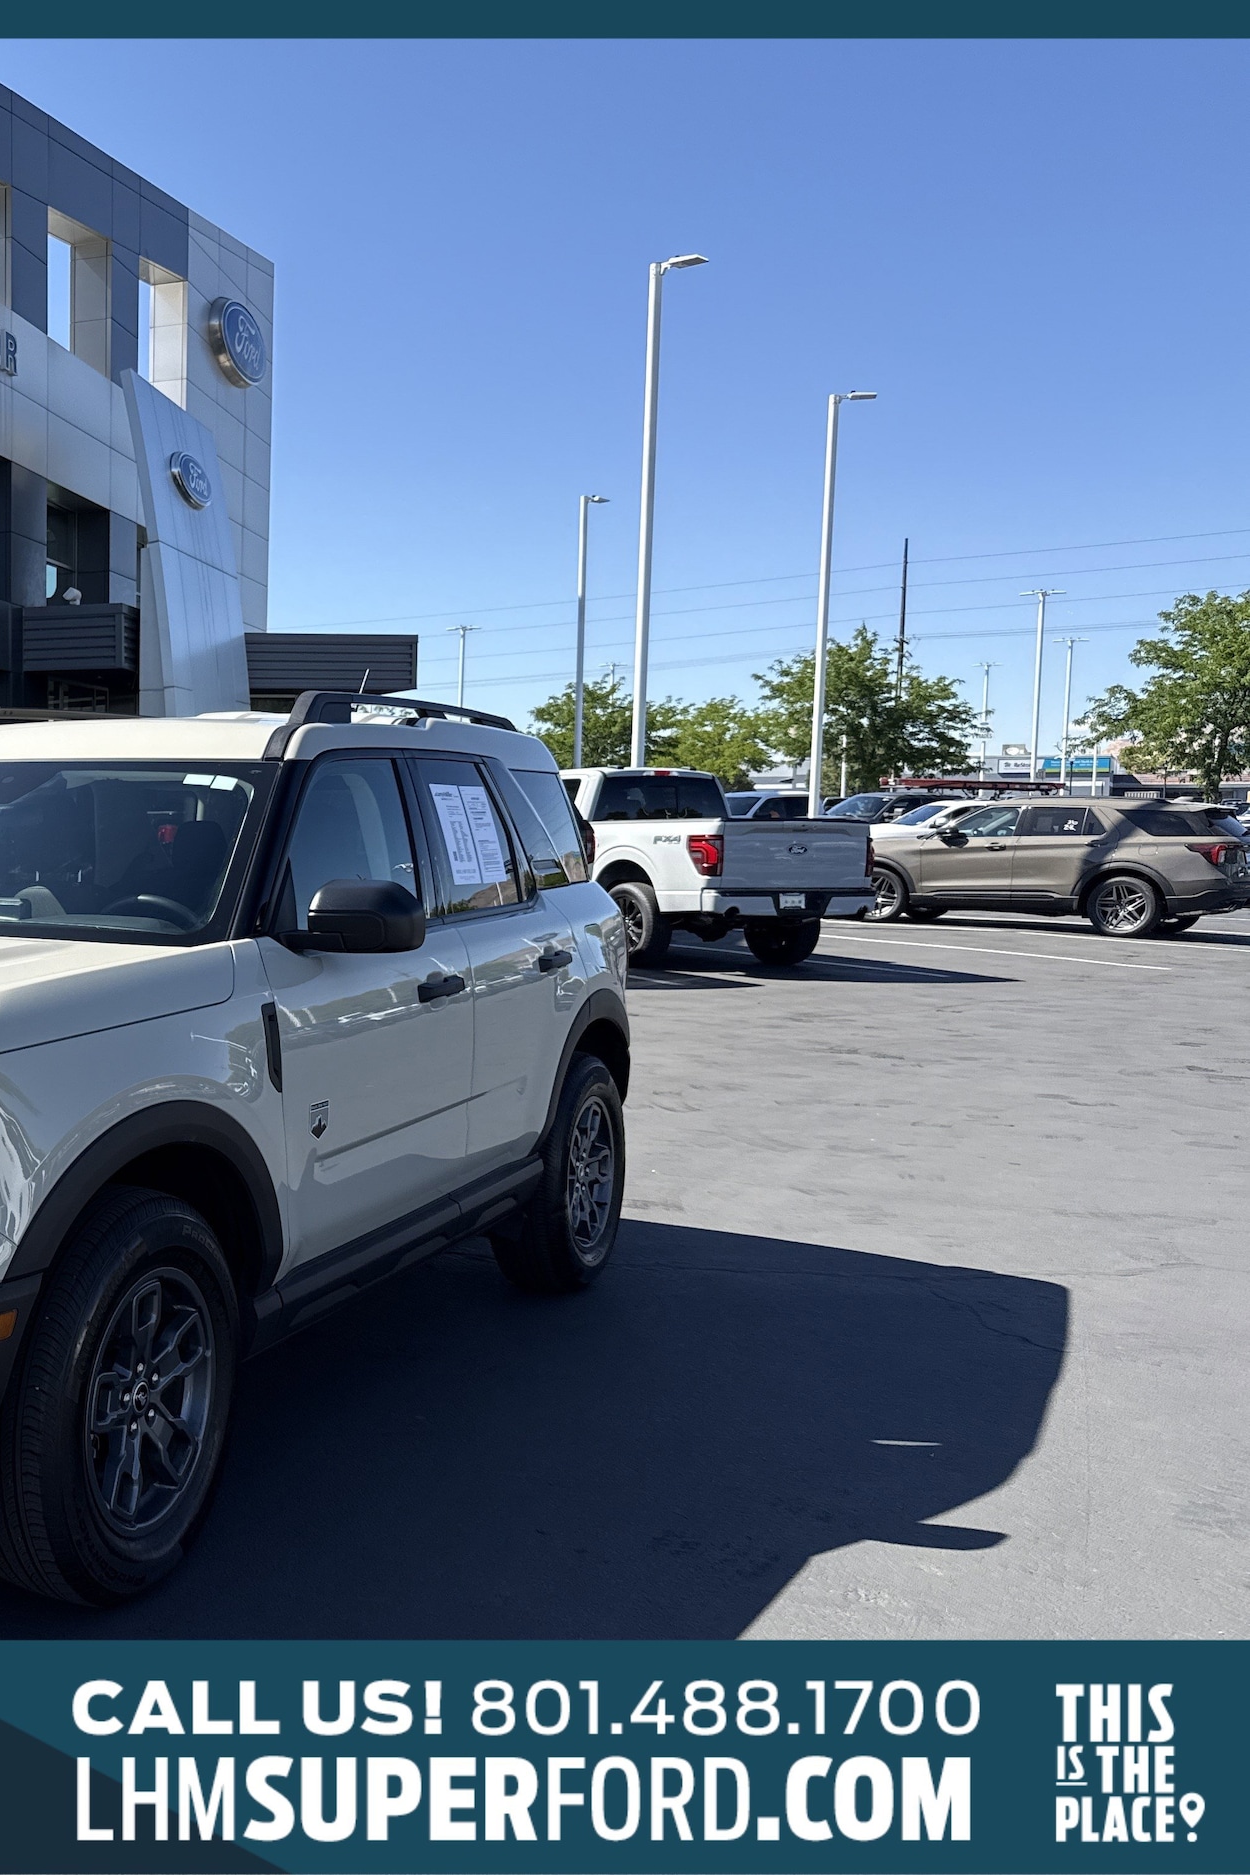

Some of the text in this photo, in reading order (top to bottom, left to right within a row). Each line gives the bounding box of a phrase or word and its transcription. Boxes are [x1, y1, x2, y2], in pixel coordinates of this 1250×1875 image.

[234, 315, 262, 371] Ford
[188, 462, 209, 497] Ford
[653, 835, 681, 845] FX4
